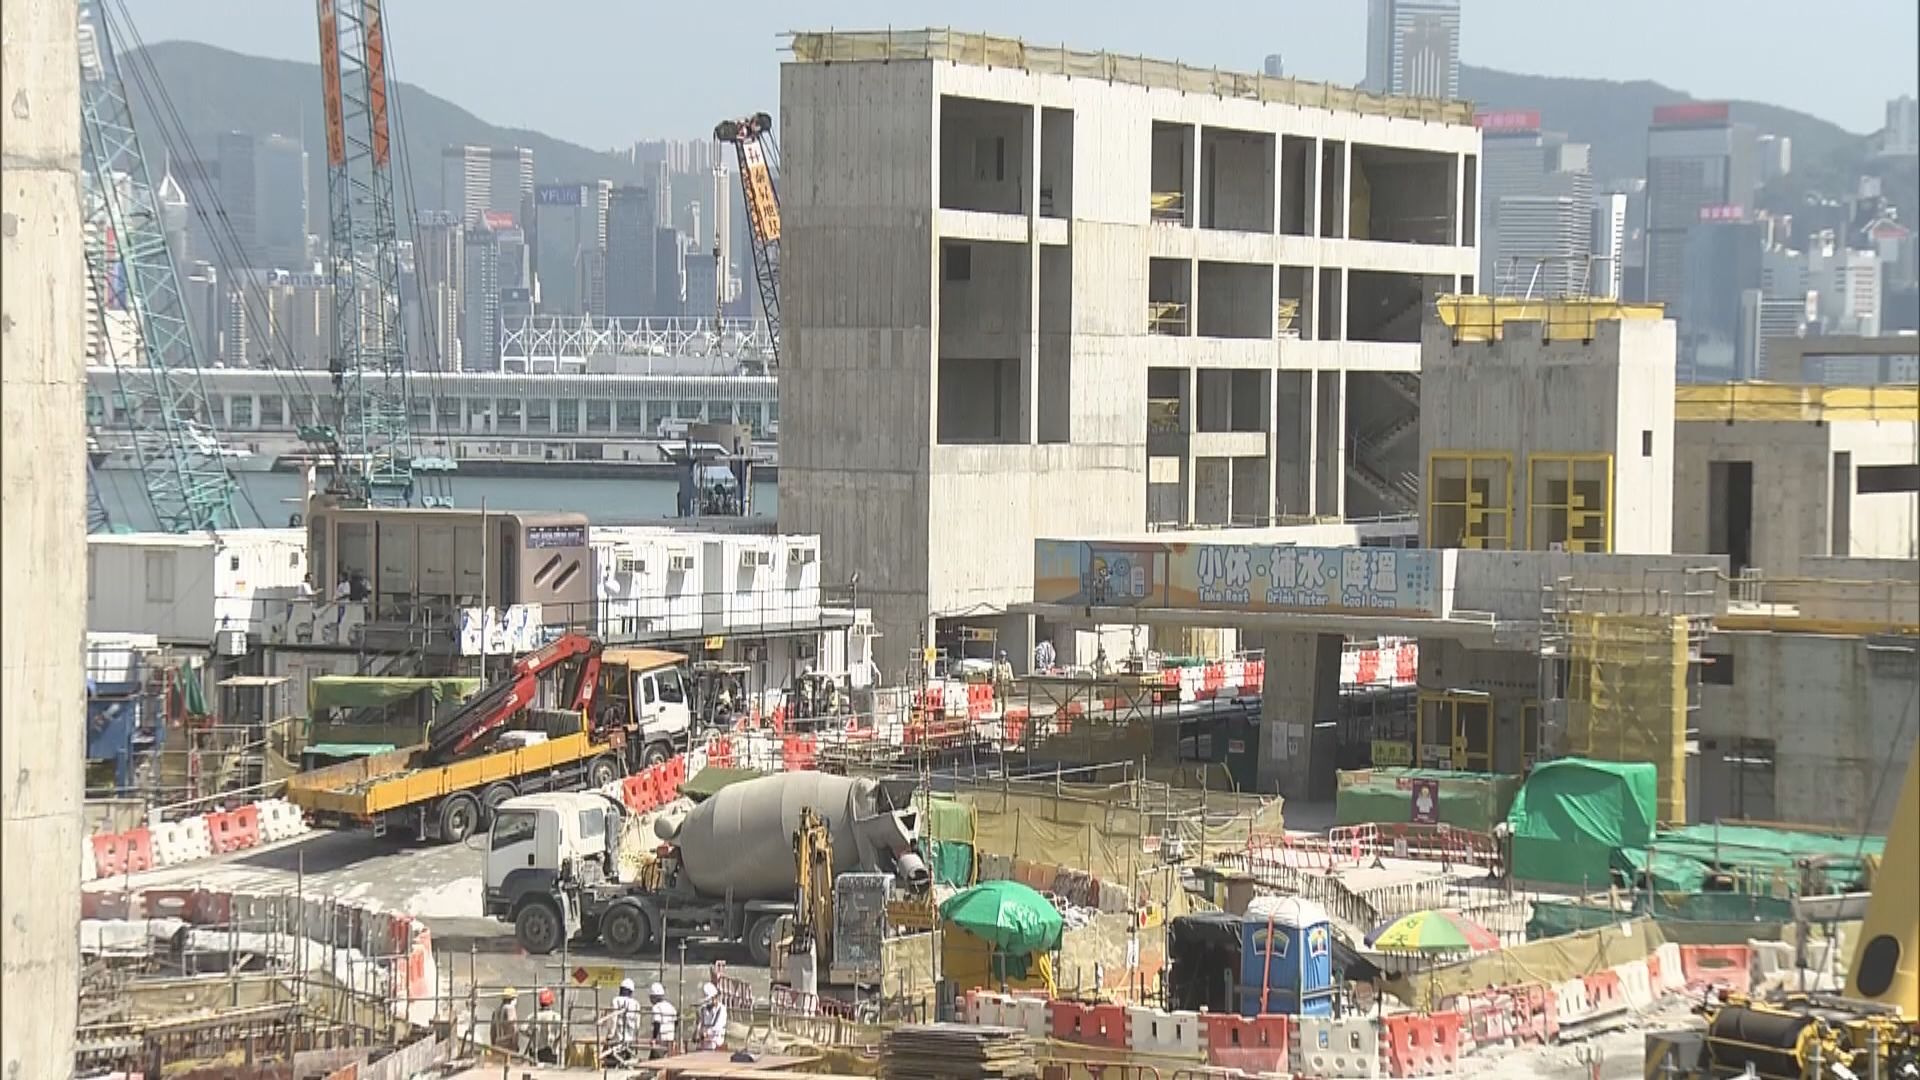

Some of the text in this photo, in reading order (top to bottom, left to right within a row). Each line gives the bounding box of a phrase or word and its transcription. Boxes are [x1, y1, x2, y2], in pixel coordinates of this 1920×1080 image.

[1199, 587, 1397, 609] Take Rest Drink Water Cool Down
